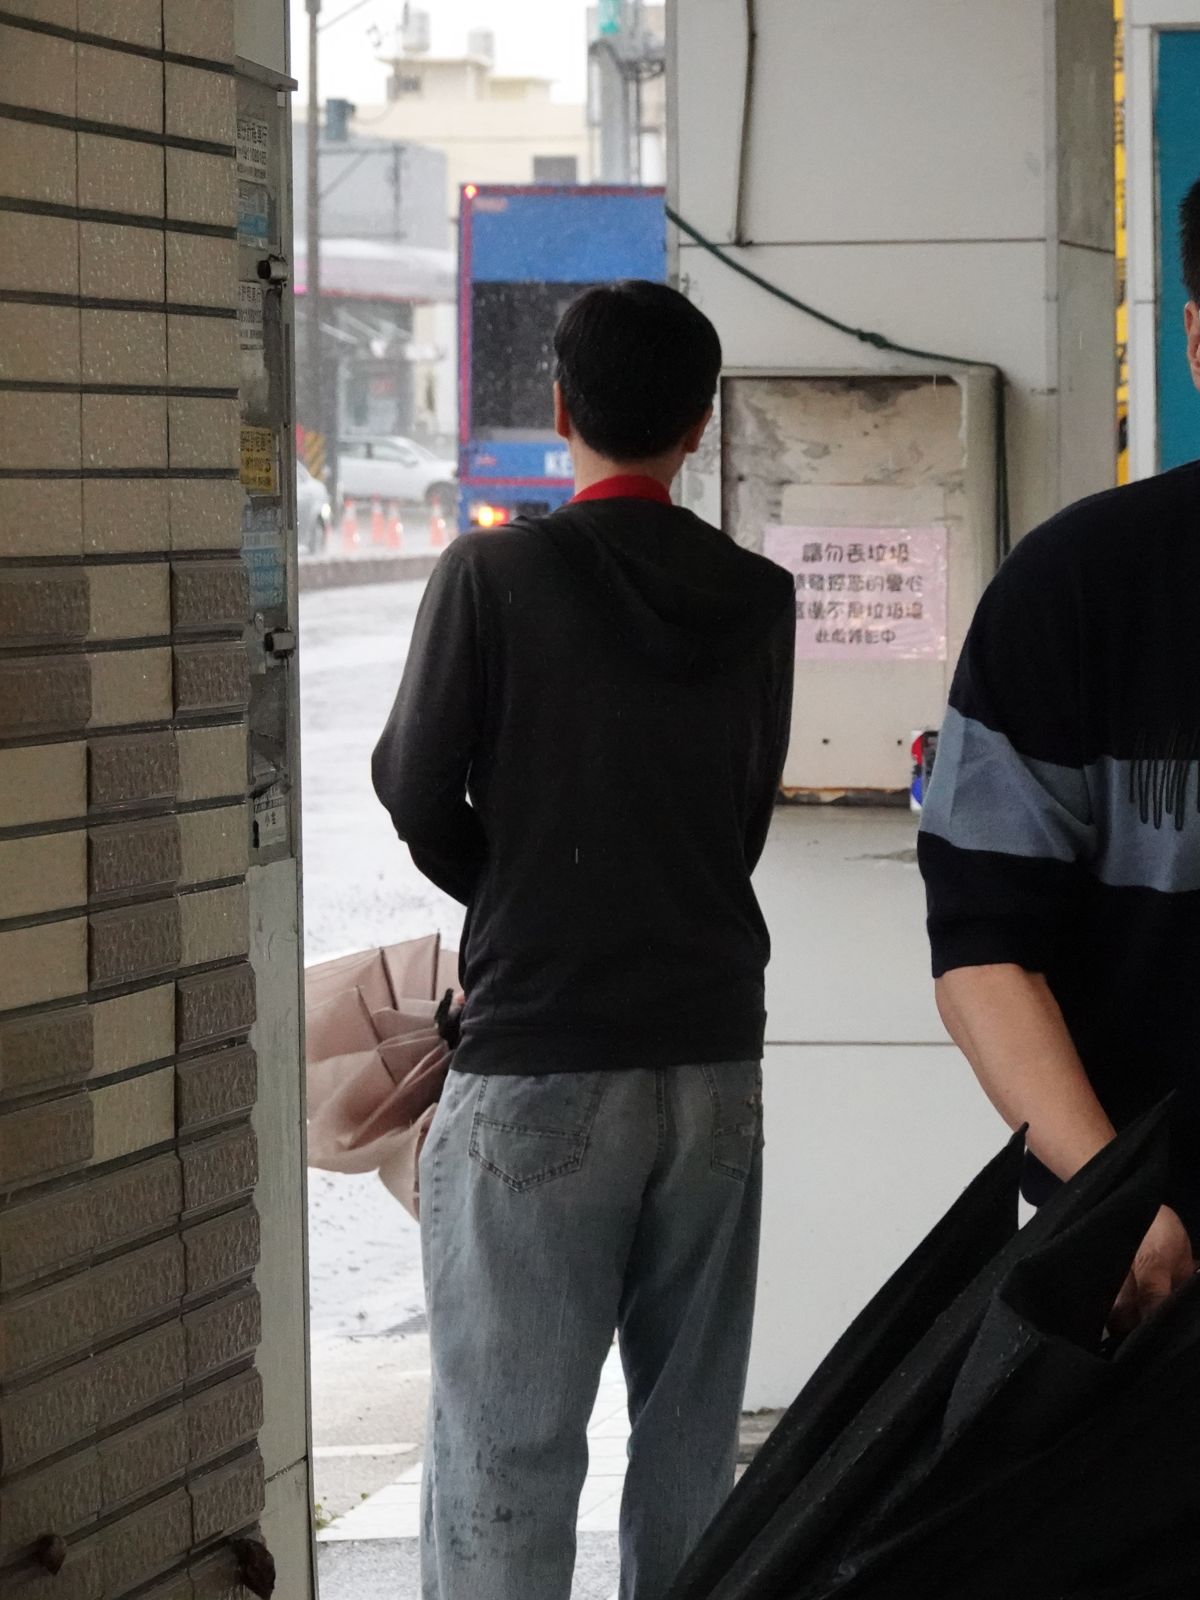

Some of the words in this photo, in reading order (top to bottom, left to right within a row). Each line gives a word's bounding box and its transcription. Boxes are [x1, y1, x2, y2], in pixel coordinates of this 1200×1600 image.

[802, 542, 909, 563] 請勿丟垃圾
